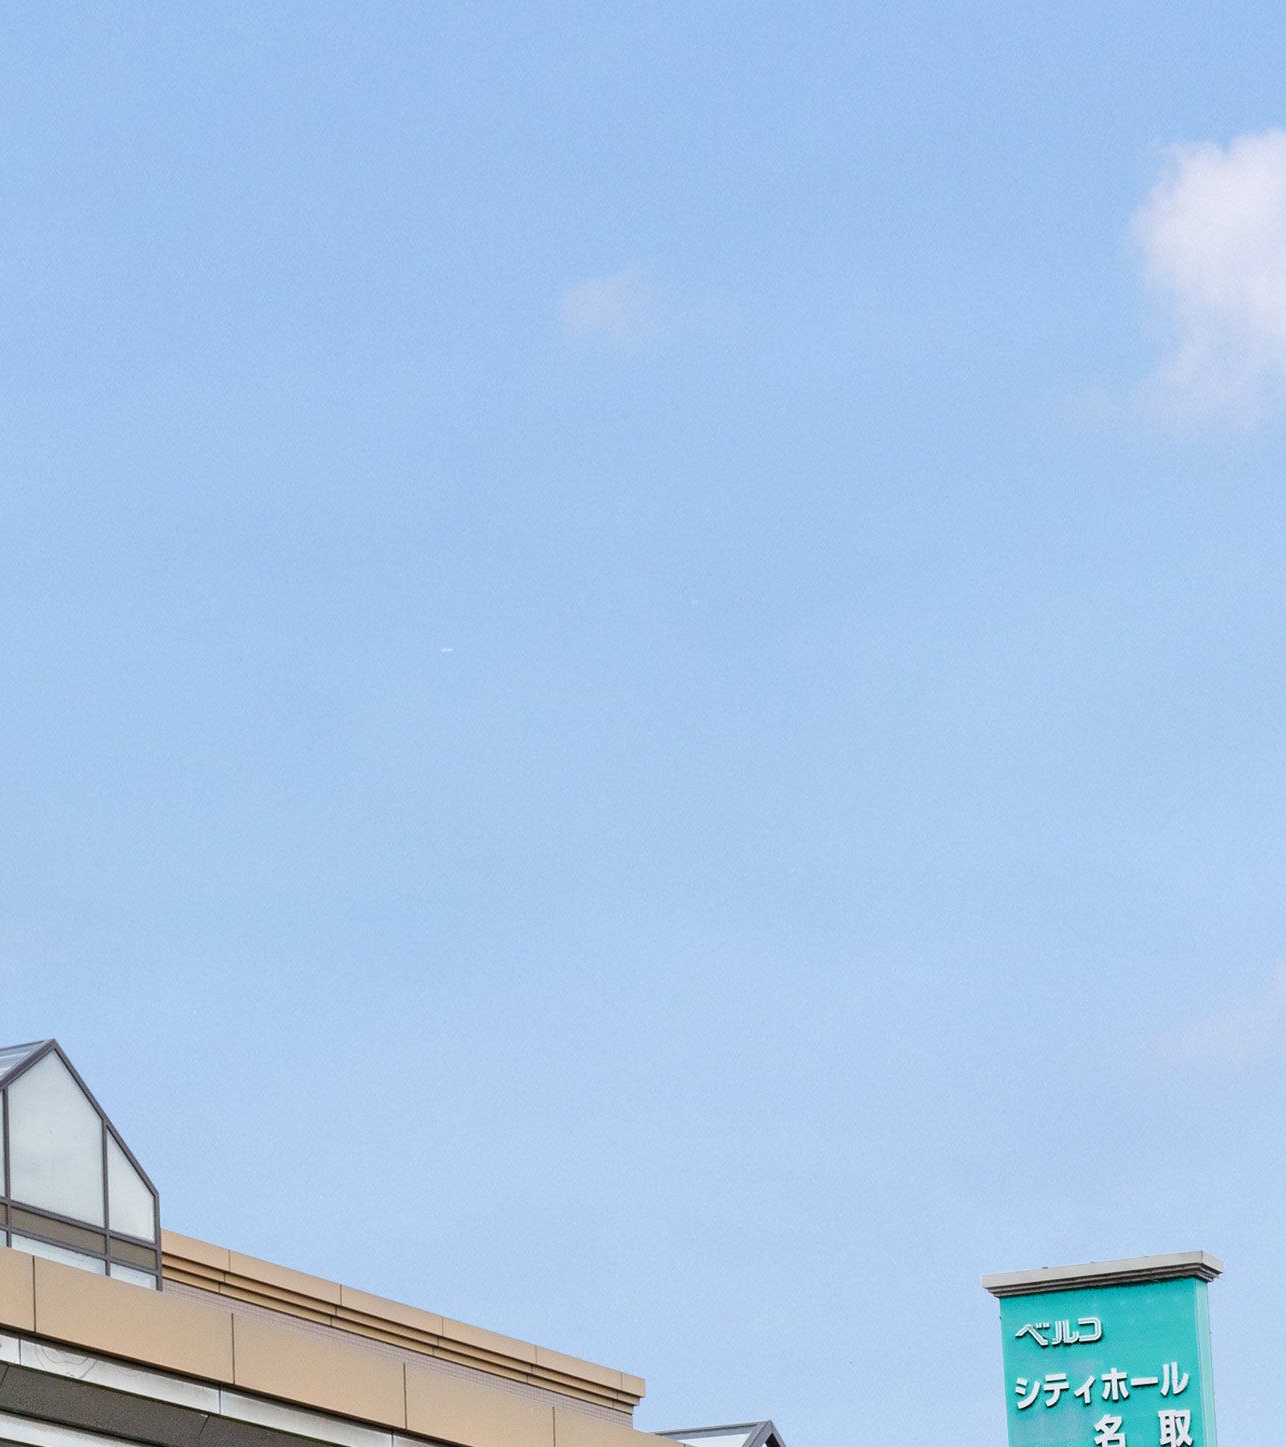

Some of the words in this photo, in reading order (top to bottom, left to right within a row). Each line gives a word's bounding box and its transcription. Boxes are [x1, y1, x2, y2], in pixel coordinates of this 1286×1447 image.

[1014, 1316, 1103, 1347] ベルコ
[1014, 1361, 1191, 1410] シティホール
